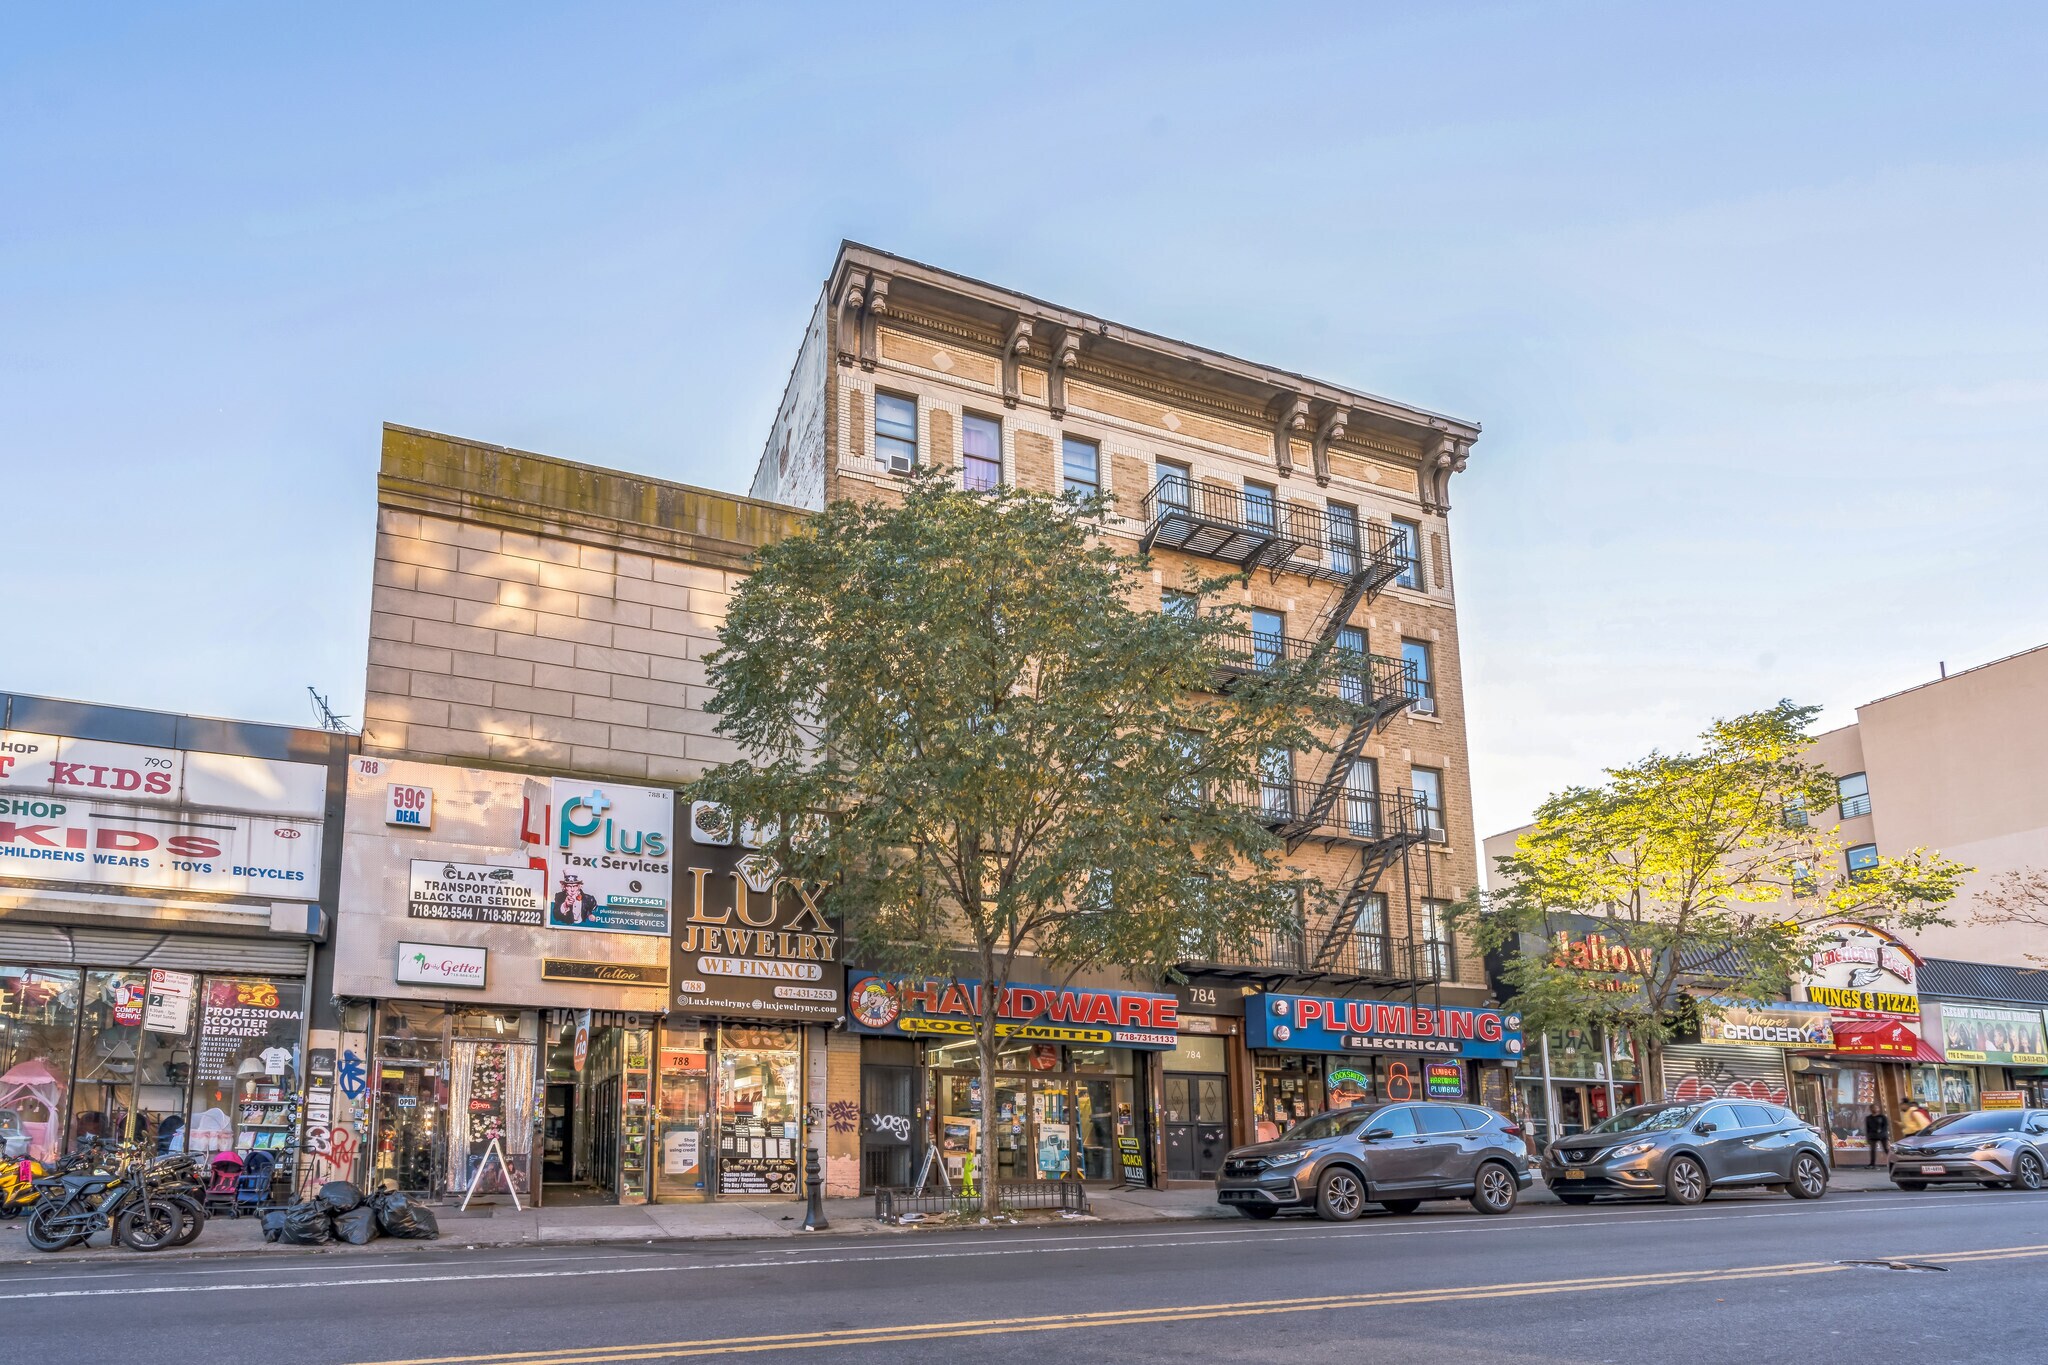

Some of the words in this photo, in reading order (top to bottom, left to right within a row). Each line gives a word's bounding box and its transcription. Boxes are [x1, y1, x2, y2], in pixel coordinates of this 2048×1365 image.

[1, 741, 39, 754] HOP
[144, 757, 173, 769] 790
[360, 760, 378, 774] 788
[47, 761, 172, 795] KIDS
[393, 786, 425, 811] 59¢
[0, 798, 67, 818] SHOP
[395, 809, 421, 824] DEAL
[559, 789, 667, 856] Plus
[0, 821, 222, 859] KIDS
[277, 829, 299, 839] 790
[93, 853, 150, 868] WEARS
[172, 860, 212, 874] TOYS
[233, 866, 305, 881] BICYCLES
[562, 852, 592, 867] Tax
[601, 856, 669, 875] Services
[446, 870, 488, 882] CLAY
[424, 880, 532, 897] TRANSPORTATION
[414, 891, 454, 902] BLACK
[458, 894, 483, 905] CAR
[487, 896, 536, 908] SERVICE
[610, 895, 663, 906] (917)473-6431
[687, 866, 835, 933] LUX
[412, 903, 473, 920] 718-942-5544
[482, 908, 541, 924] 718-367-2222
[595, 916, 665, 928] PLUSTAXSERVICES
[681, 925, 838, 962] JEWELRY
[704, 957, 732, 974] WE
[739, 960, 818, 979] FINANCE
[1813, 941, 1877, 971] American
[1881, 948, 1913, 984] Best
[594, 965, 640, 980] Tattoo
[684, 981, 702, 991] 788
[777, 987, 834, 999] 347-431-2553
[1189, 988, 1216, 1003] 784
[152, 996, 160, 1006] 2
[688, 996, 751, 1009] LuxJewelrynyc
[763, 1000, 837, 1013] luxjewelrynyc.com
[900, 979, 1179, 1029] HARDWARE
[1809, 985, 1861, 1009] WINGS
[1864, 991, 1874, 1009] &
[1877, 993, 1920, 1013] PIZZA
[203, 1016, 268, 1028] SCOOTER
[1297, 999, 1503, 1042] PLUMBING
[1744, 1014, 1790, 1028] Mapes
[1005, 1025, 1104, 1041] SMITH
[1119, 1032, 1175, 1044] 718-731-1133
[1723, 1024, 1812, 1042] GROCERY
[575, 1034, 585, 1057] ria
[1351, 1037, 1459, 1052] ELECTRICAL
[672, 1056, 690, 1066] 788
[1185, 1050, 1201, 1060] 784
[1332, 1070, 1365, 1083] LOCKSMITH
[1431, 1067, 1457, 1076] LUMBER
[1429, 1077, 1460, 1085] HARDWARE
[239, 1103, 283, 1112] $299.99
[399, 1098, 416, 1106] OPEN
[470, 1101, 490, 1110] Open
[1122, 1153, 1142, 1166] ROACH
[1124, 1166, 1145, 1179] KILLER
